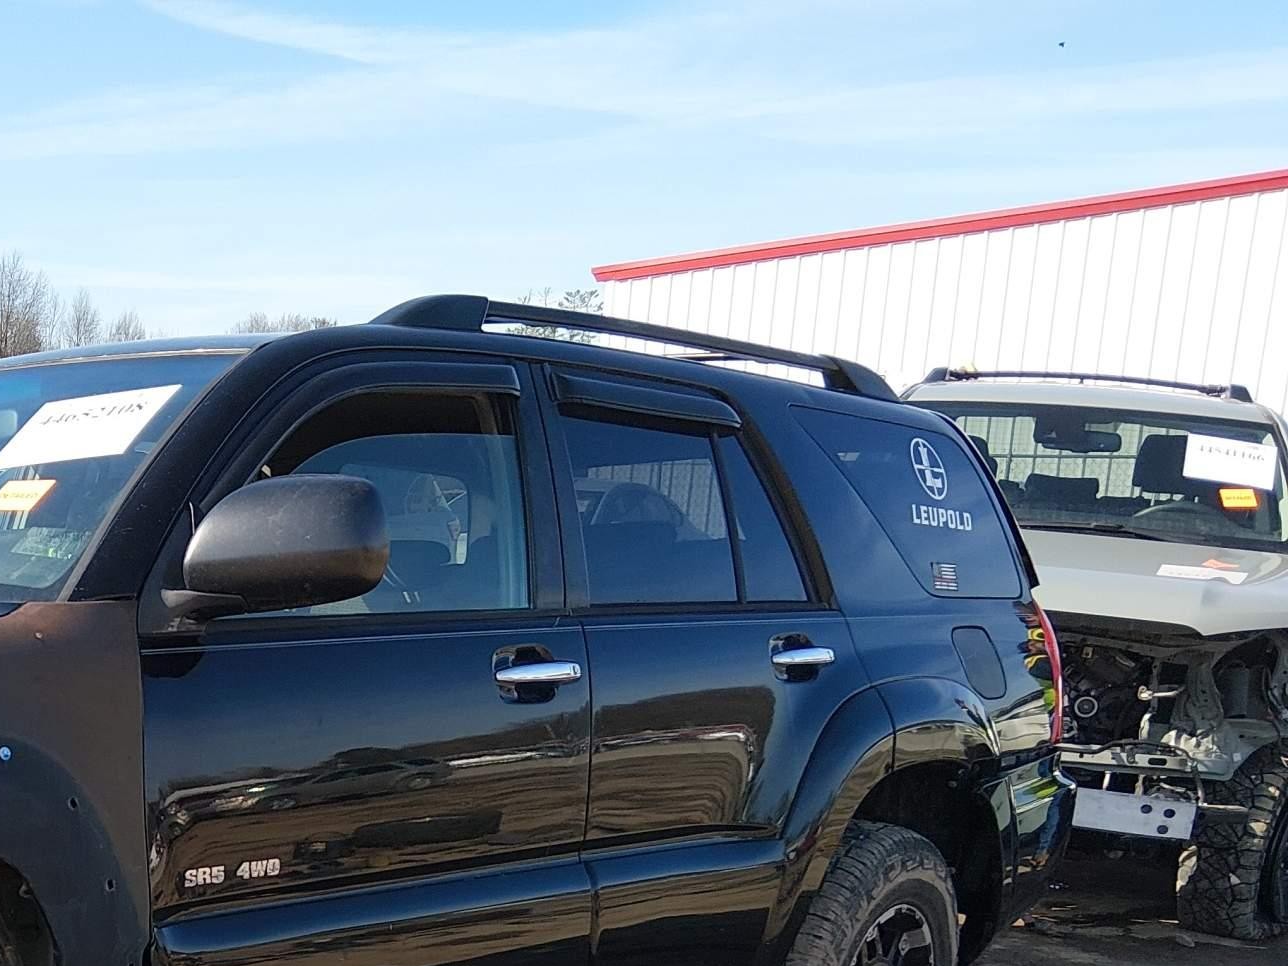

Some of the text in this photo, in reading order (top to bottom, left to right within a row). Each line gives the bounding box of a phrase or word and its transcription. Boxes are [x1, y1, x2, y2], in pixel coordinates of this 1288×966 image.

[912, 504, 972, 530] LEUPOLD
[184, 858, 280, 887] SR5 4WD
